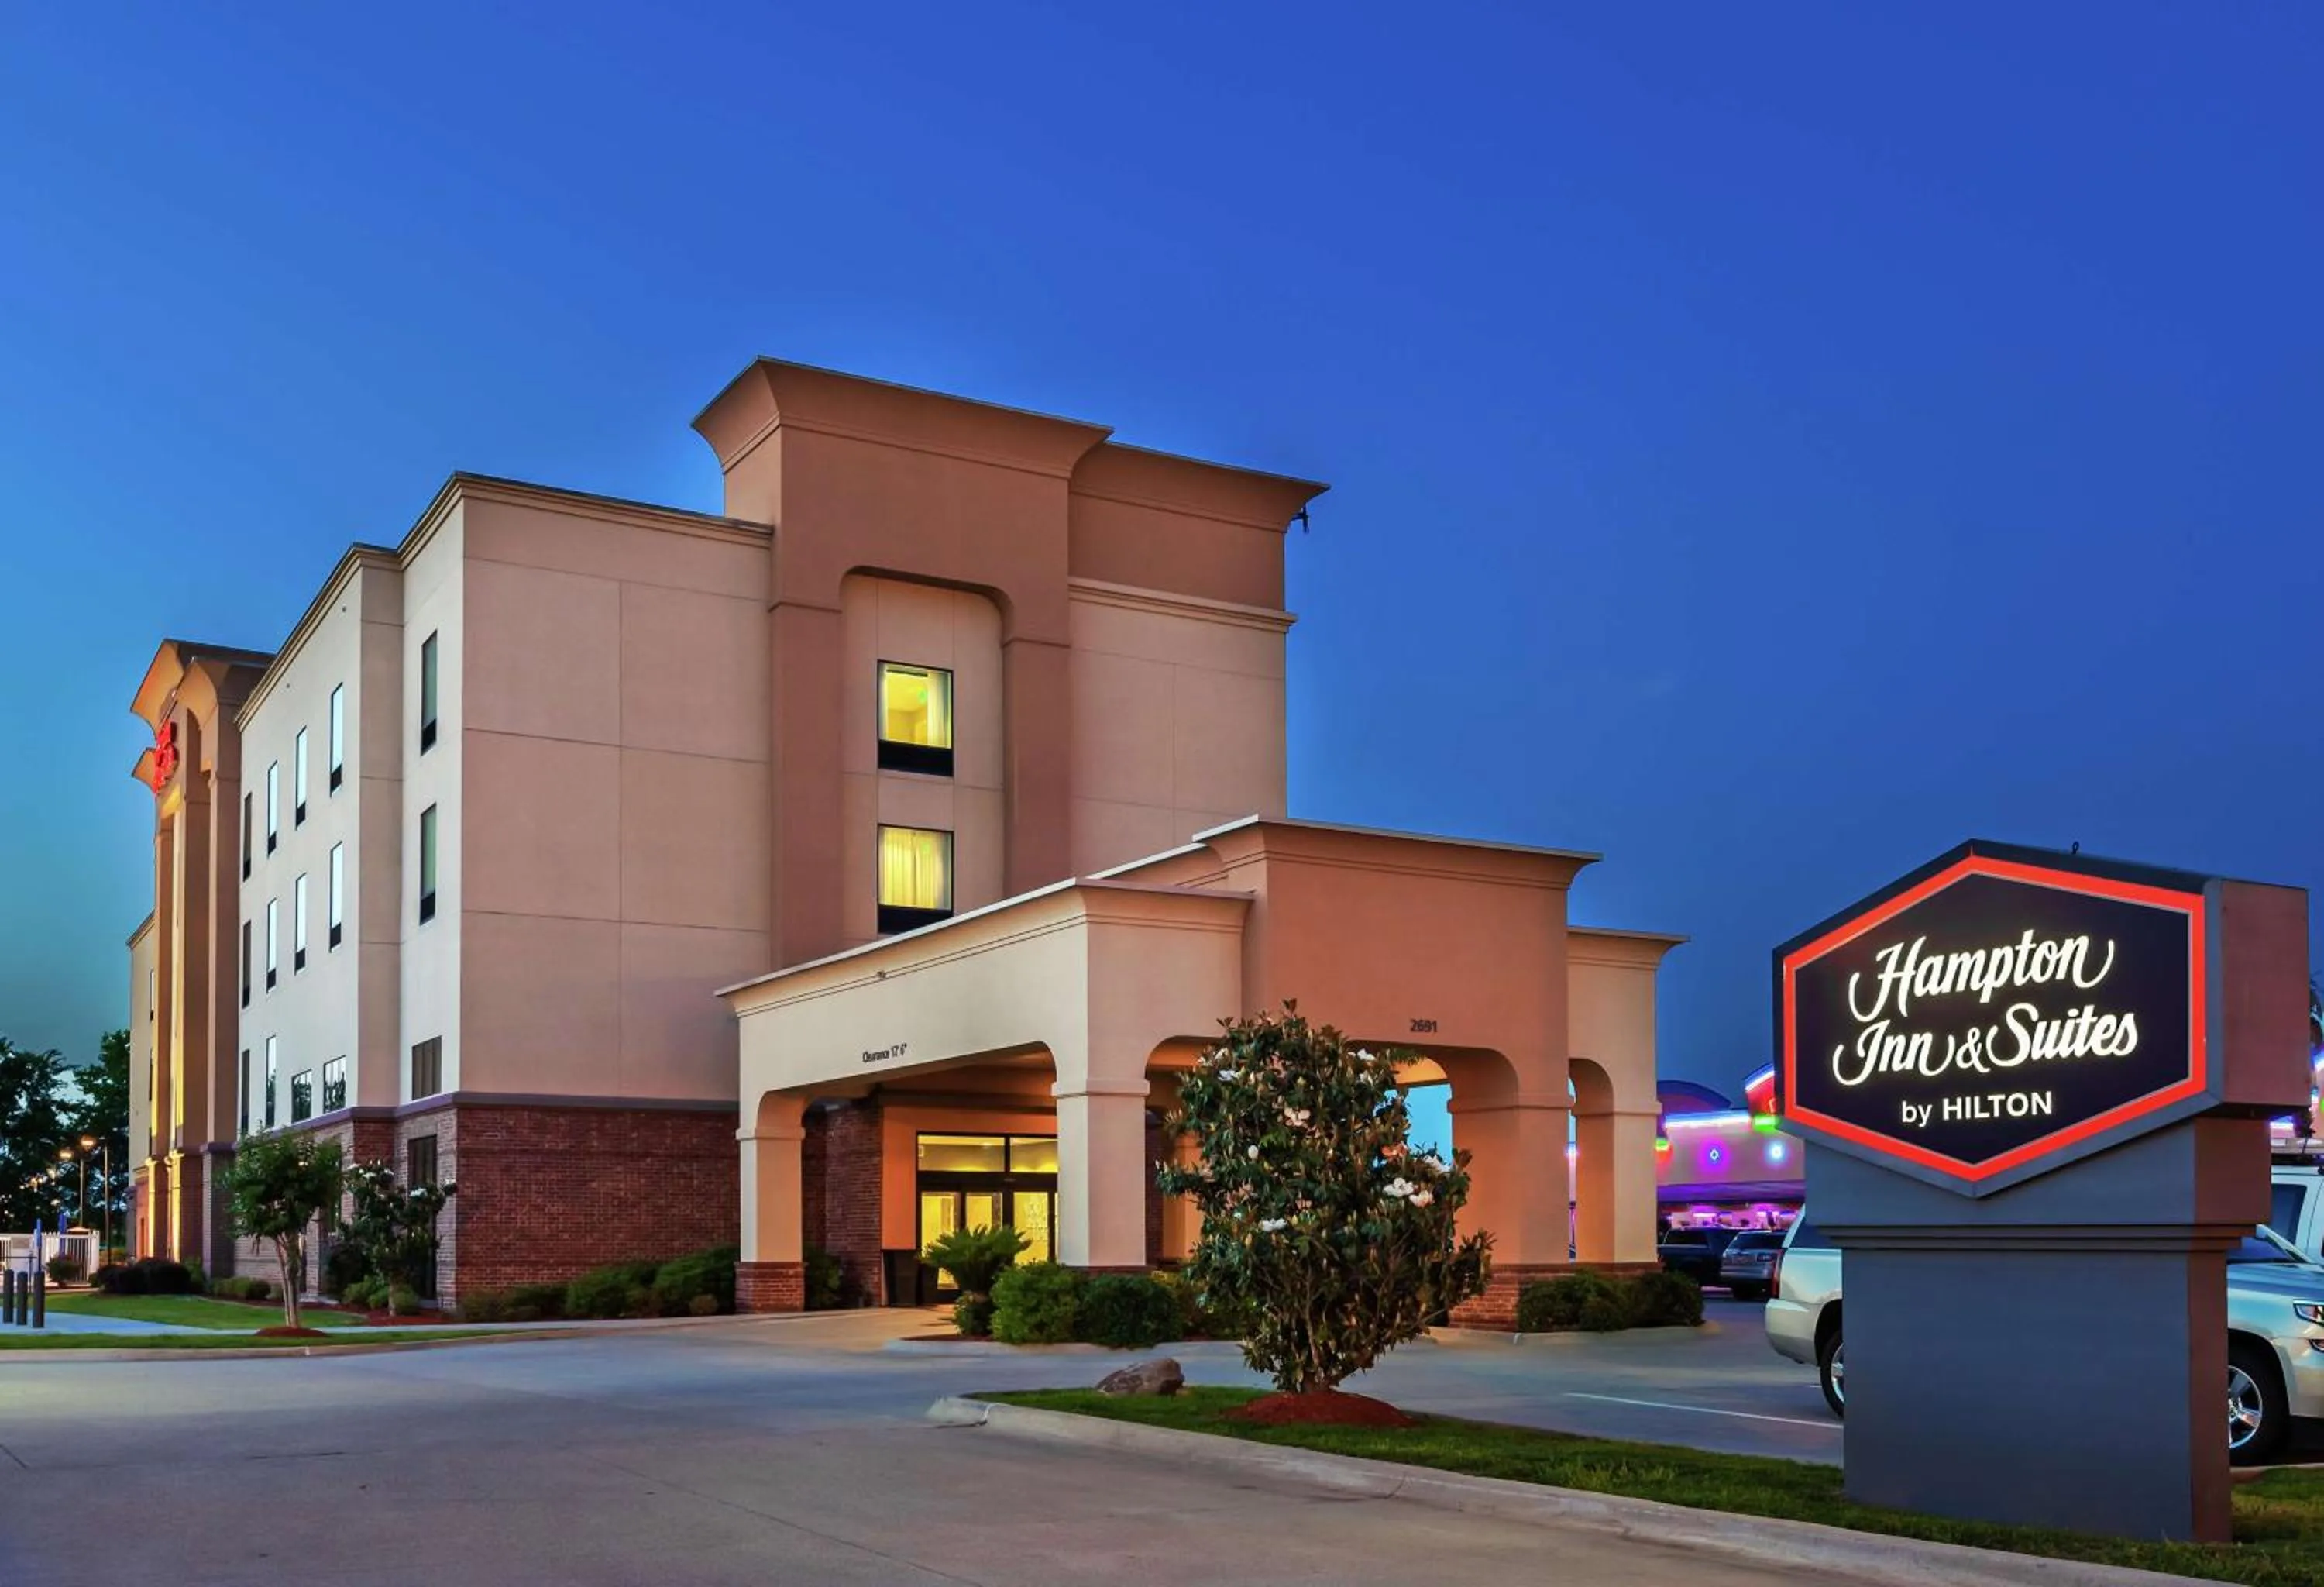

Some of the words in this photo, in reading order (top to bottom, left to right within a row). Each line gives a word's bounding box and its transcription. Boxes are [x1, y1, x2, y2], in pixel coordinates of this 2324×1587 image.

[1848, 929, 2115, 1023] Hampton
[1832, 1019, 1956, 1086] Inn
[1985, 1002, 2139, 1068] Suites
[1902, 1100, 1933, 1127] by
[1943, 1090, 2053, 1121] HILTON
